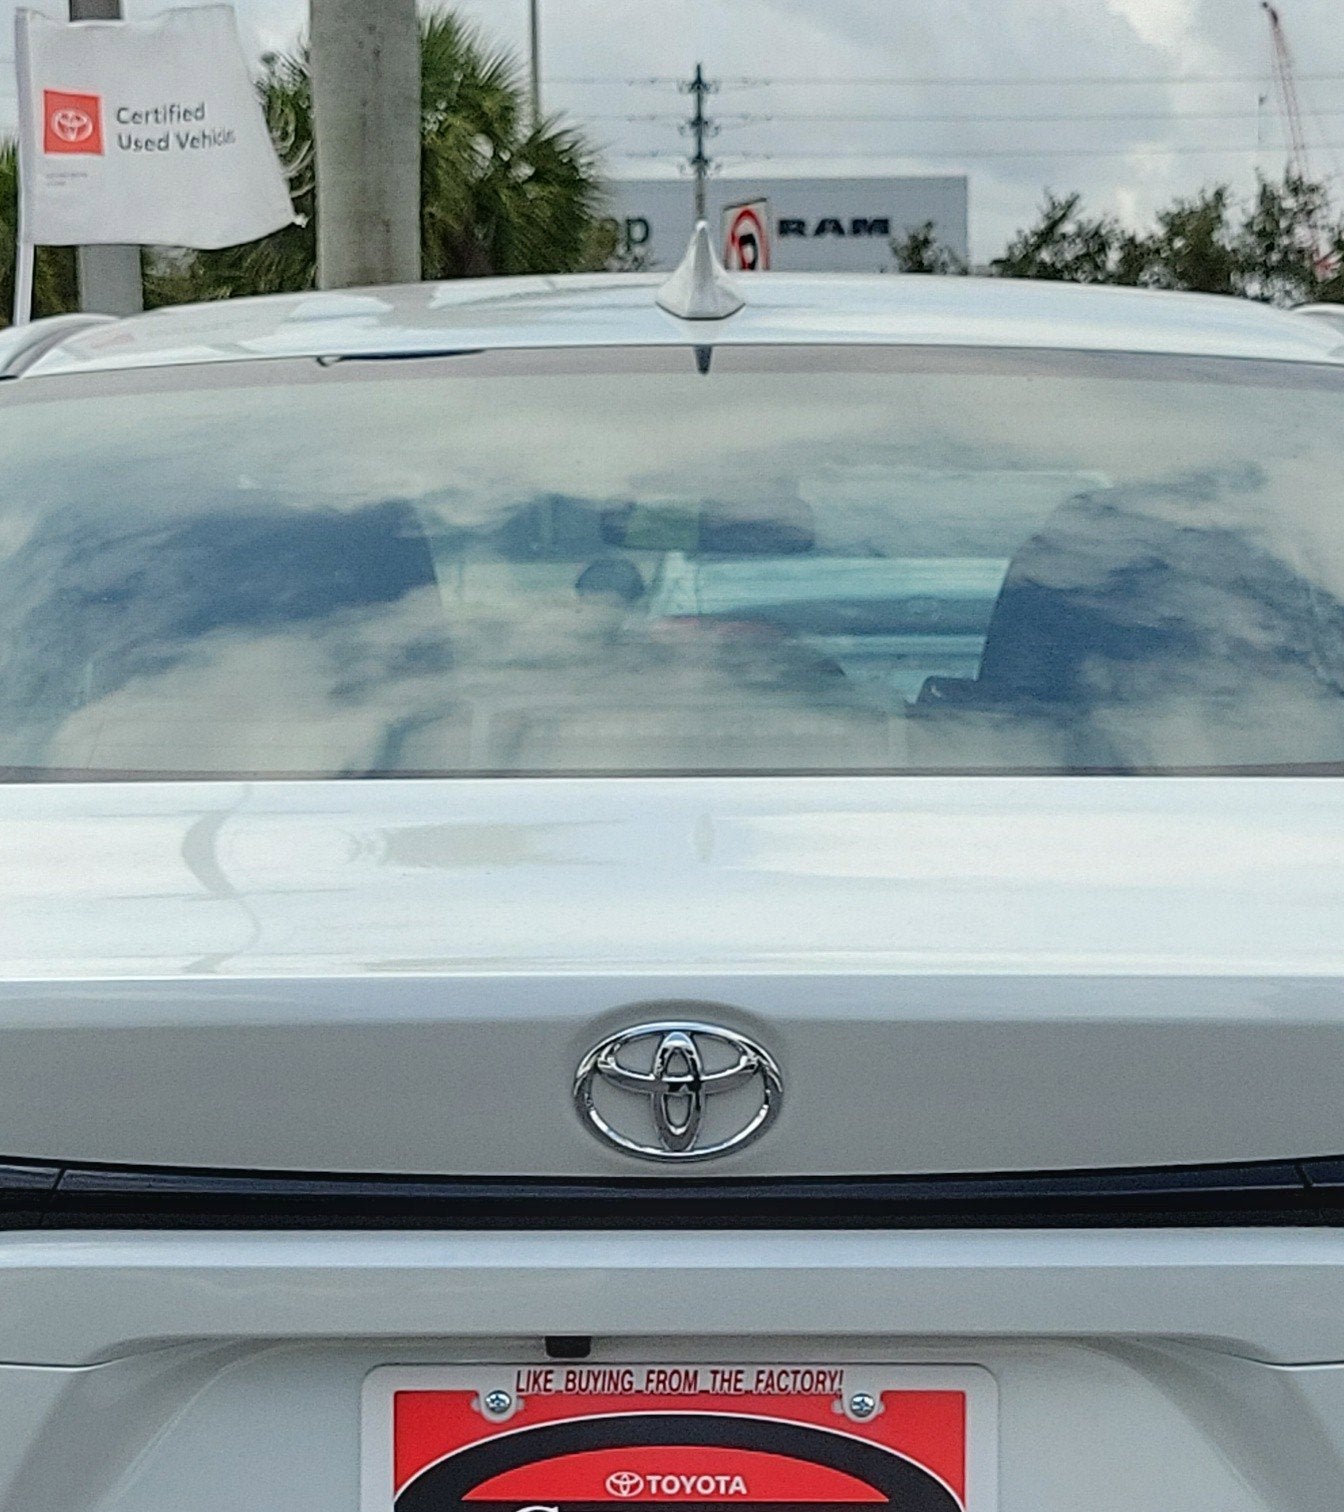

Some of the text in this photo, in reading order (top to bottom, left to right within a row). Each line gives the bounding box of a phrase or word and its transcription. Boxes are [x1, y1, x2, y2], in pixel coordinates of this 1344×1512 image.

[116, 102, 206, 125] Certified
[117, 132, 170, 152] Used
[778, 217, 890, 237] RAM
[516, 1369, 845, 1393] LIKE BUYING FROM THE FACTORY!
[646, 1475, 747, 1495] TOYOTA
